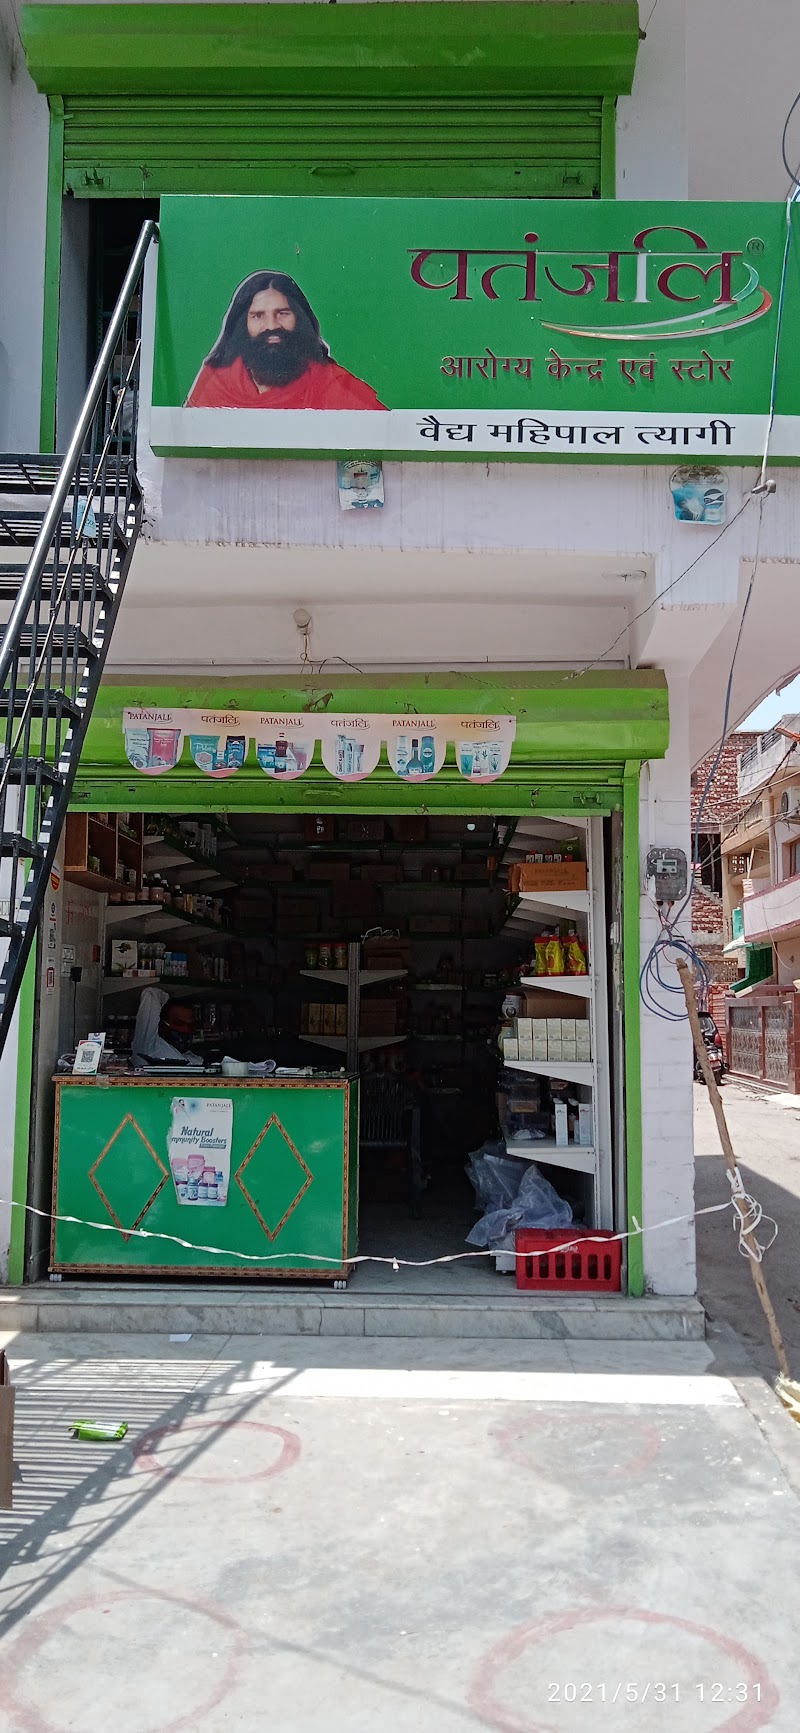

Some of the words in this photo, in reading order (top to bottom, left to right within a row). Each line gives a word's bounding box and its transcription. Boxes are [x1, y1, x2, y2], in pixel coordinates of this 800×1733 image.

[406, 225, 744, 304] पतंजलि
[440, 347, 534, 380] आरोग्य
[545, 348, 606, 382] केन्द्र
[618, 353, 658, 386] एवं
[669, 350, 735, 382] स्टोर
[416, 415, 477, 443] वैद्य
[487, 417, 624, 445] महिपाल
[635, 419, 736, 446] त्यागी
[201, 714, 239, 724] पतंजलि
[460, 719, 498, 729] पतंजलि
[181, 1126, 214, 1136] Natural
[172, 1136, 200, 1144] mmunity
[200, 1136, 227, 1144] Boosters
